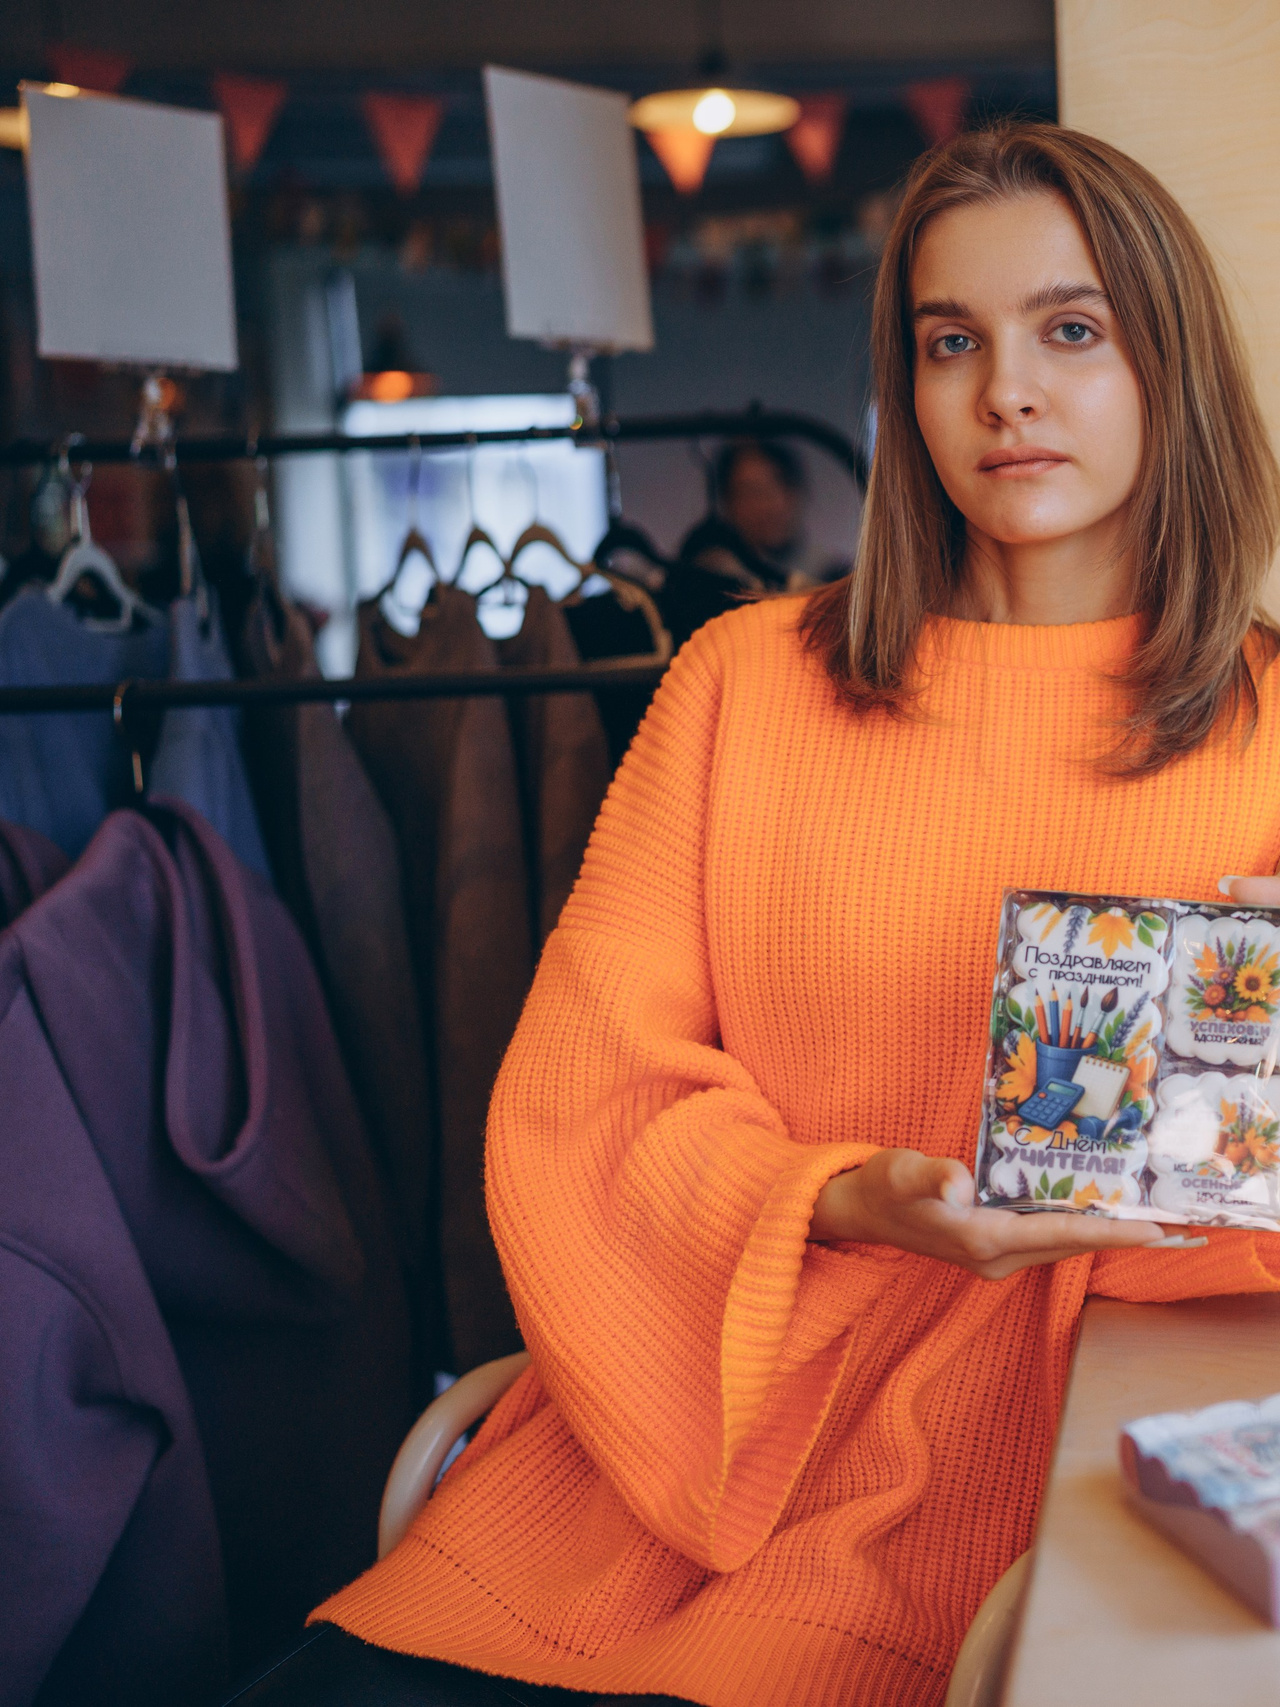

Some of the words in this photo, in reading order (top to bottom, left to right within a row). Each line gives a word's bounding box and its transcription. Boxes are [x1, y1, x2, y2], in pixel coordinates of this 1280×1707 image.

[1024, 945, 1152, 974] Поздравляем
[1028, 967, 1039, 979] с
[1048, 969, 1143, 988] праздником!
[1190, 1020, 1256, 1036] УСПЕХОВ
[1013, 1127, 1032, 1146] С
[1045, 1130, 1107, 1154] Днём
[1003, 1146, 1127, 1175] УЧИТЕЛЯ!
